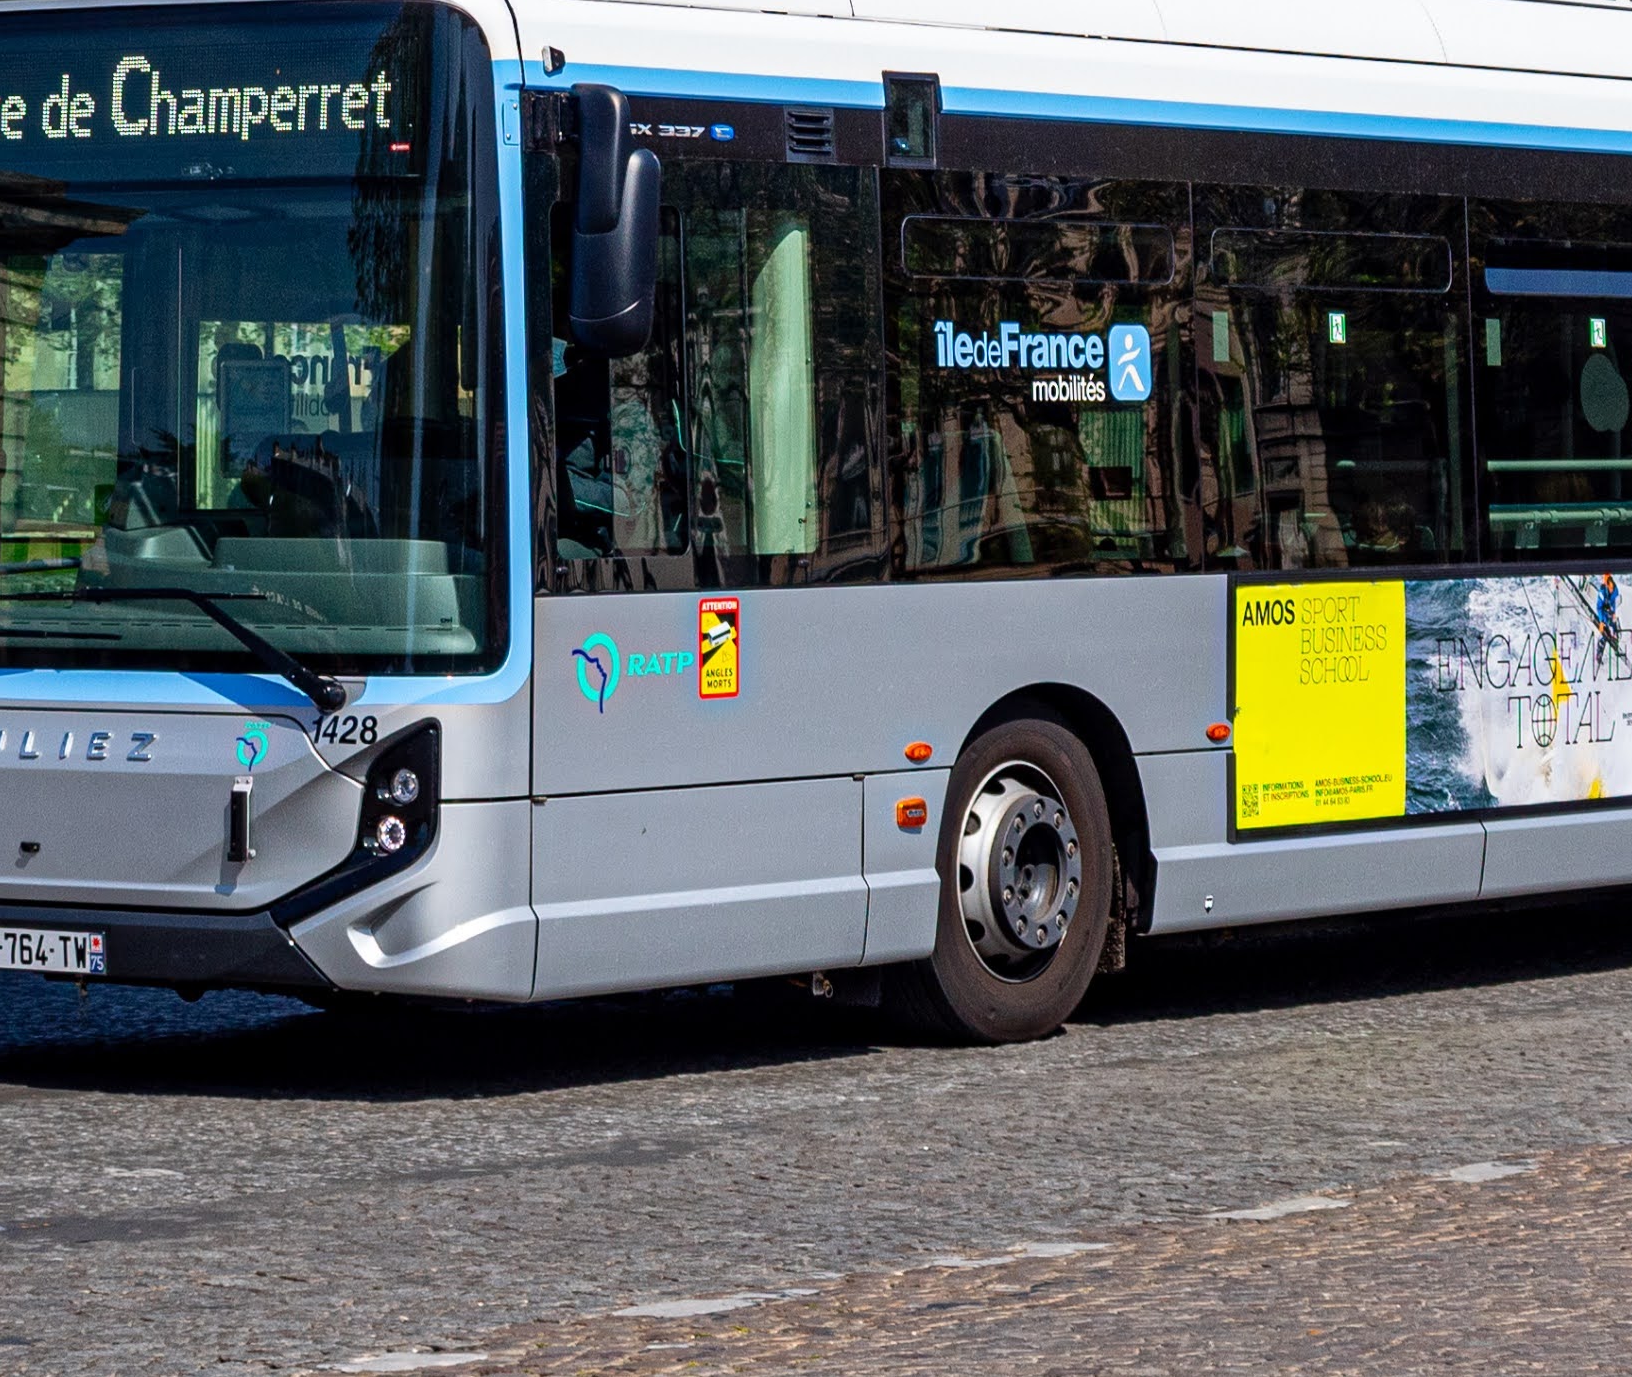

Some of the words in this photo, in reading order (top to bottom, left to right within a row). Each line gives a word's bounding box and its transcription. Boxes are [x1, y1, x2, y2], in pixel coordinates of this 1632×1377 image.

[41, 73, 95, 139] de
[110, 56, 392, 140] Champerret
[657, 124, 705, 138] 337
[1032, 372, 1106, 402] mobilités
[701, 600, 738, 611] ATTENTION
[1242, 599, 1296, 627] AMOS
[1301, 596, 1361, 625] SPORT
[1300, 624, 1387, 655] BUSINESS
[626, 651, 695, 677] RATP
[706, 667, 733, 678] ANGLES
[1299, 655, 1371, 685] SCHOOL
[707, 678, 732, 689] MORTS
[312, 715, 378, 745] 1428
[90, 955, 105, 971] 75
